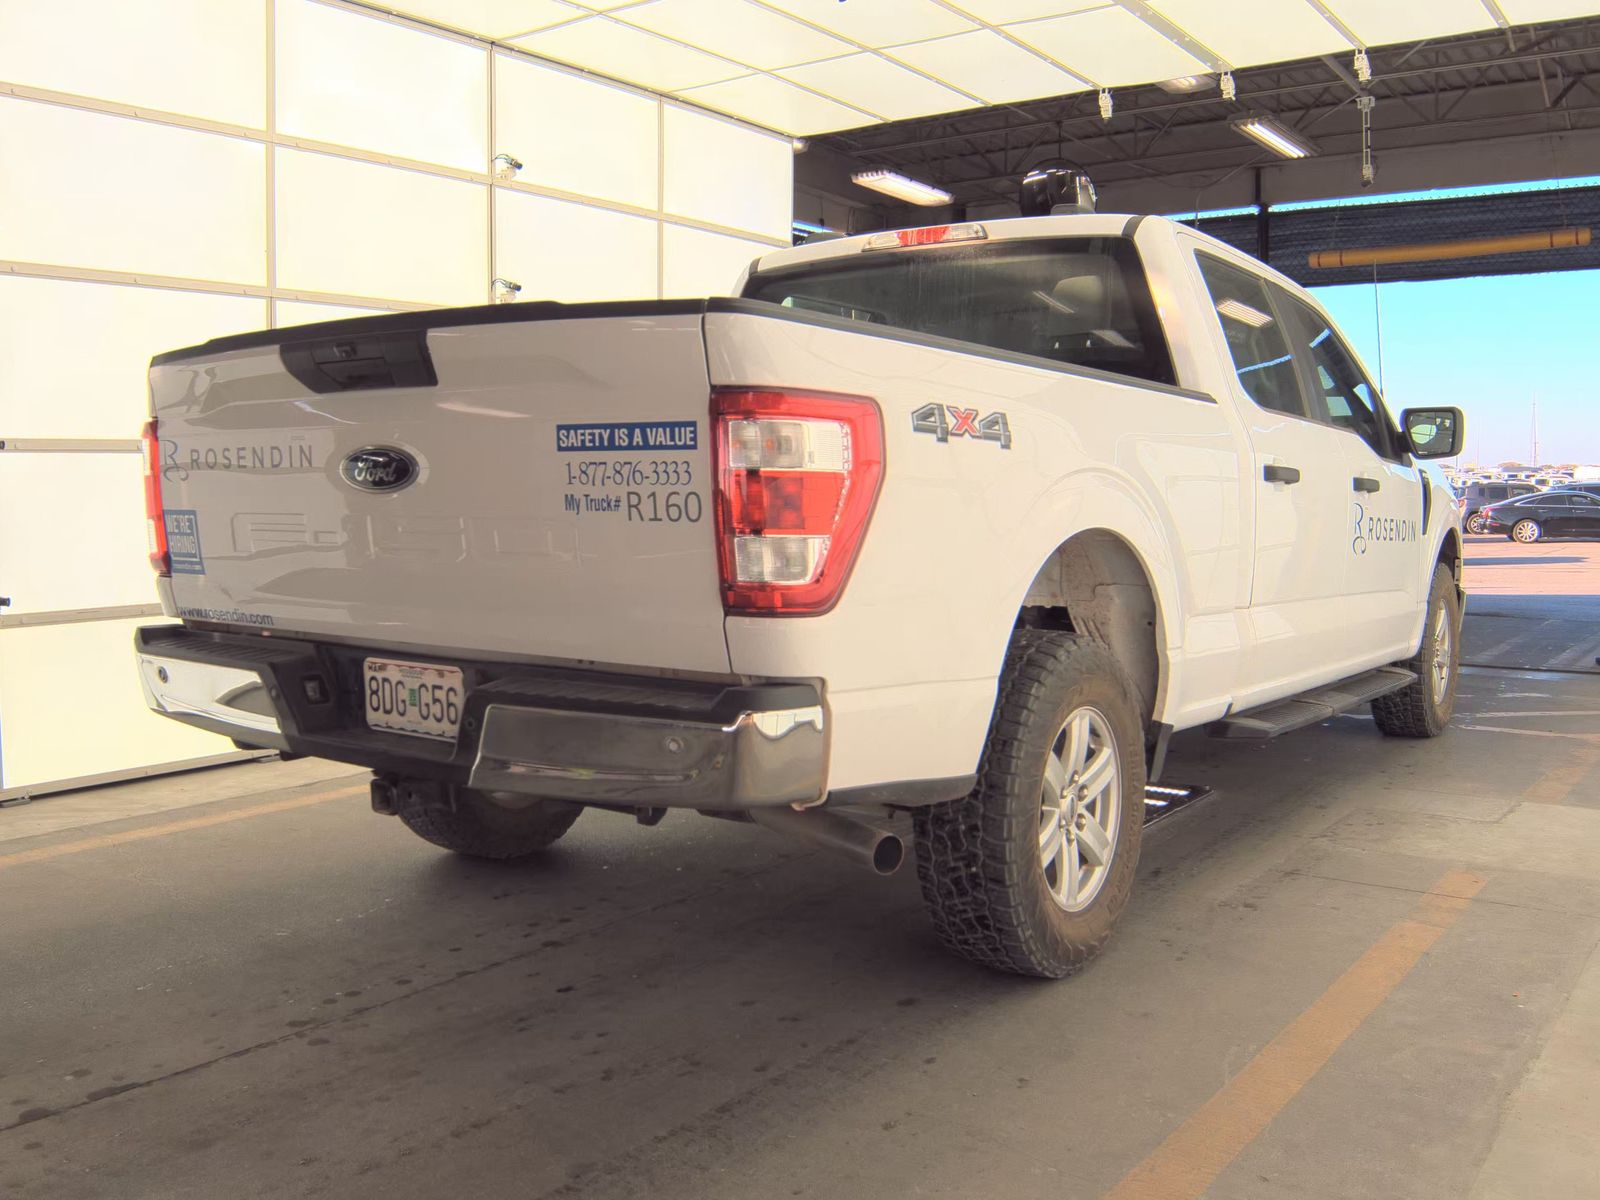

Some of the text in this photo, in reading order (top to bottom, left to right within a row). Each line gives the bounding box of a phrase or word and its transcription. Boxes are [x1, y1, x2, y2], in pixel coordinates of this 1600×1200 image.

[559, 426, 695, 447] SAFETY IS A VALUE
[190, 445, 313, 470] ROSENDIN
[565, 461, 692, 486] 1-877-876-3333
[564, 494, 581, 515] My
[626, 491, 702, 523] R160
[1368, 517, 1417, 542] ROSENDIN
[369, 676, 407, 717] 8DG
[418, 683, 458, 726] G56
